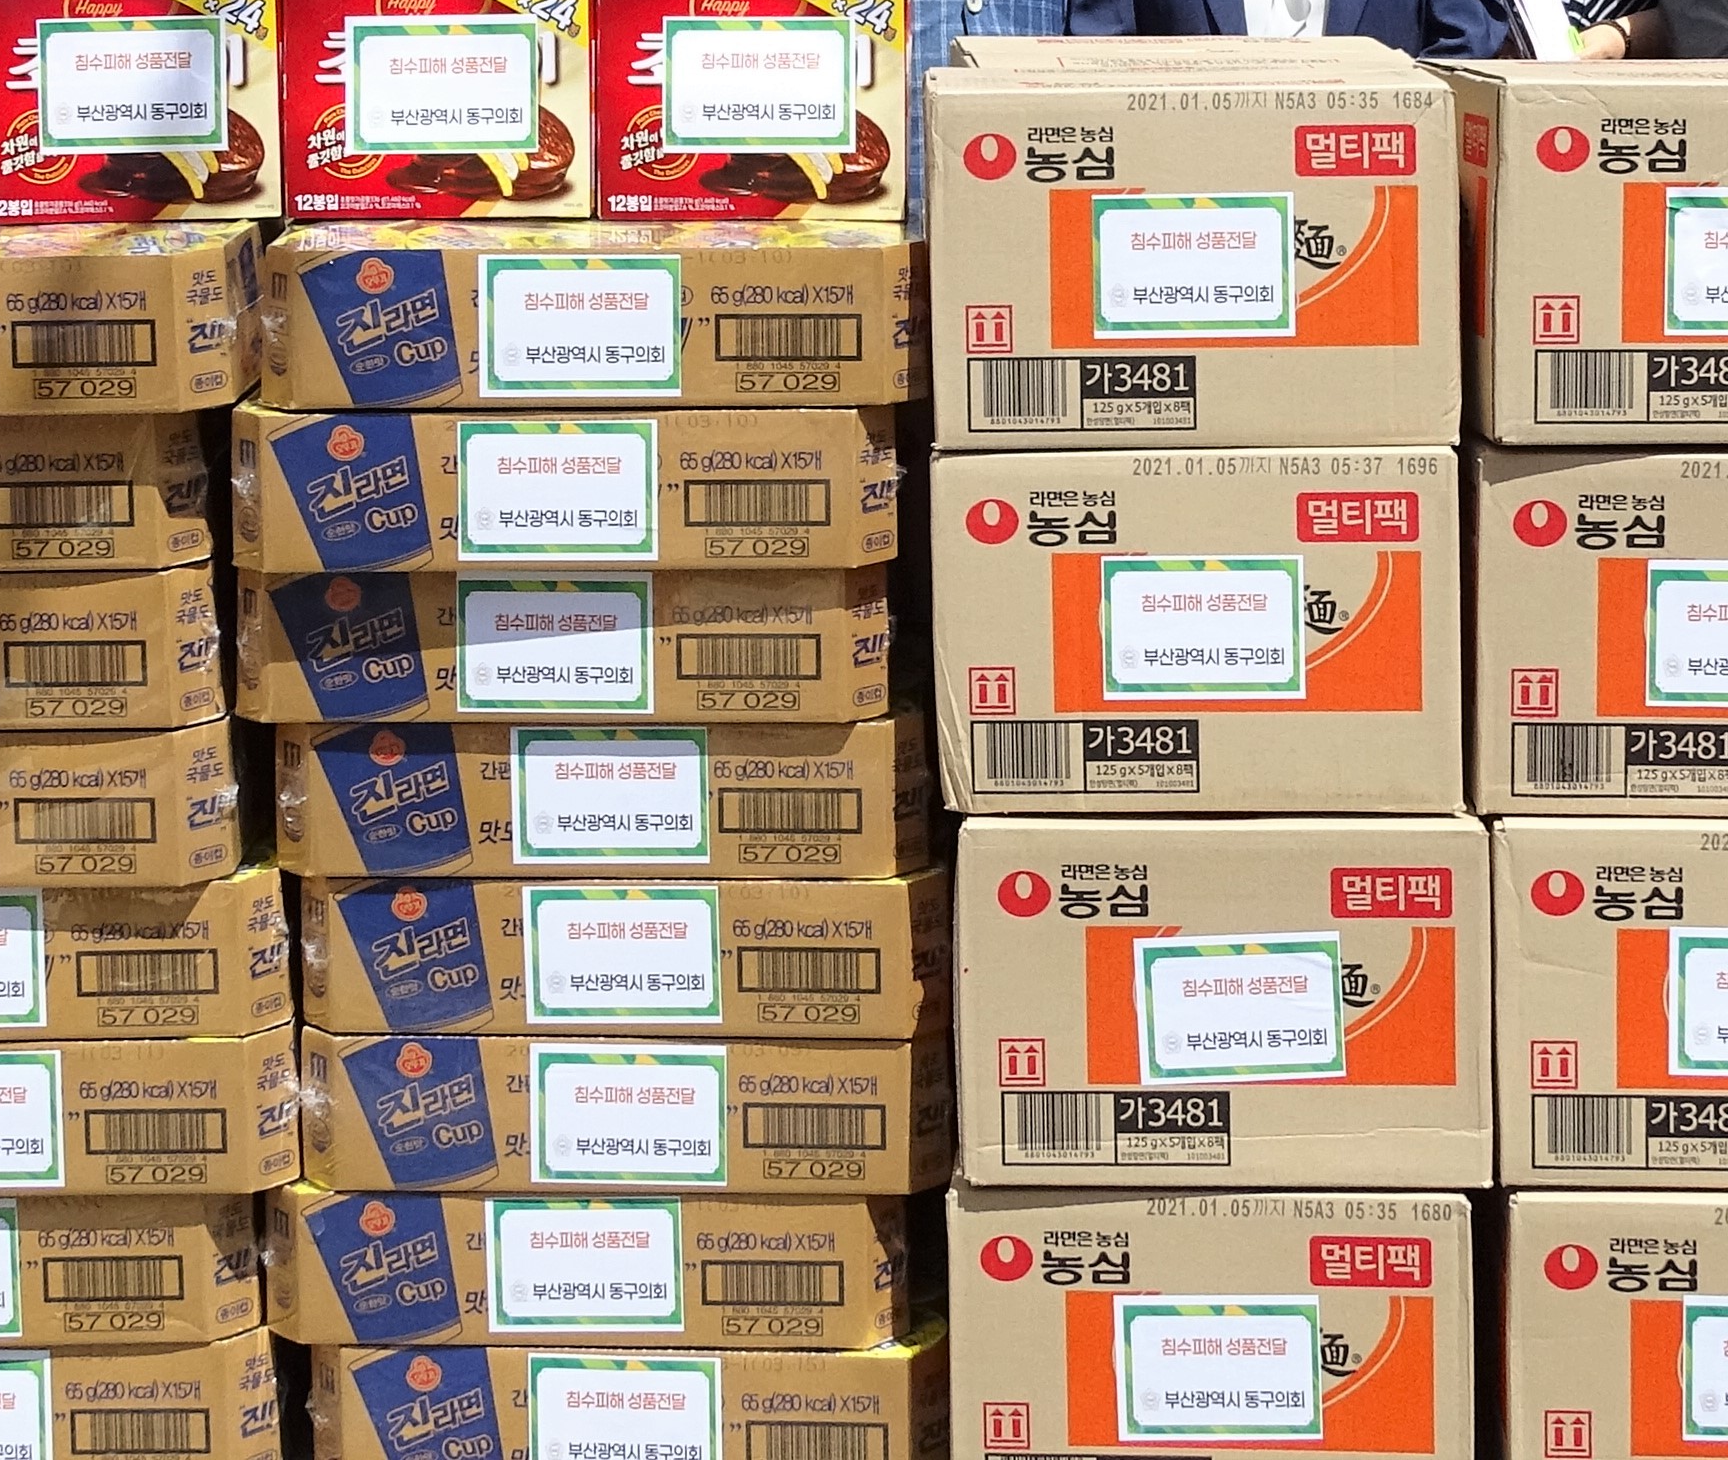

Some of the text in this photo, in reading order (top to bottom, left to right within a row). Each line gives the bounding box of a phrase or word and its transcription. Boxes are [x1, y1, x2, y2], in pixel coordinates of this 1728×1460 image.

[76, 0, 123, 16] Happy
[389, 57, 507, 75] 침수피해 성품전달
[1274, 92, 1317, 110] N5A3
[1327, 92, 1379, 109] 05:35
[1393, 91, 1433, 109] 1684
[390, 108, 523, 125] 부산광역시 동구의회
[1601, 119, 1686, 134] 라면은 농심
[1027, 127, 1114, 143] 라면은 농심
[1305, 132, 1406, 169] 멀티팩
[1597, 138, 1687, 173] 농심
[1024, 145, 1115, 182] 농심
[295, 195, 338, 210] 12봉입
[608, 196, 652, 212] 12봉입
[1130, 231, 1257, 250] 침수피해 성품전달
[192, 270, 217, 286] 맛도
[186, 287, 223, 305] 국물도
[524, 292, 650, 312] 침수피해 성품전달
[711, 287, 729, 304] 65
[776, 284, 808, 306] kcal)
[1133, 285, 1274, 304] 부산광역시 동구의회
[336, 288, 439, 356] 진라면
[394, 336, 447, 366] Cup
[525, 344, 666, 365] 부산광역시 동구의회
[38, 380, 134, 397] 57 029
[740, 374, 837, 390] 57 029
[1085, 363, 1189, 395] 가3481
[1279, 459, 1320, 477] N5A3
[1331, 458, 1382, 476] 05:37
[1398, 457, 1438, 476] 1696
[307, 453, 409, 519] 진라면
[1308, 499, 1407, 535] 멀티팩
[1026, 511, 1117, 546] 농심
[1575, 513, 1666, 549] 농심
[709, 538, 808, 556] 57 029
[363, 653, 414, 683] Cup
[701, 691, 798, 710] 57 029
[1088, 725, 1193, 757] 가3481
[350, 761, 447, 824] 진라면
[40, 856, 134, 874] 57 029
[1058, 883, 1149, 919] 농심
[1341, 875, 1442, 911] 멀티팩
[1592, 884, 1684, 921] 농심
[1182, 974, 1308, 997] 침수피해 성품전달
[761, 1005, 858, 1023] 57 029
[1186, 1029, 1328, 1051] 부산광역시 동구의회
[1119, 1096, 1223, 1130] 가3481
[109, 1166, 204, 1183] 57 029
[1293, 1201, 1334, 1219] N5A3
[1345, 1202, 1397, 1221] 05:35
[1411, 1203, 1452, 1222] 1680
[341, 1233, 439, 1295] 진라면
[1041, 1250, 1131, 1286] 농심
[1320, 1245, 1420, 1280] 멀티팩
[1607, 1259, 1698, 1293] 농심
[396, 1278, 446, 1306] Cup
[726, 1317, 823, 1335] 57 029
